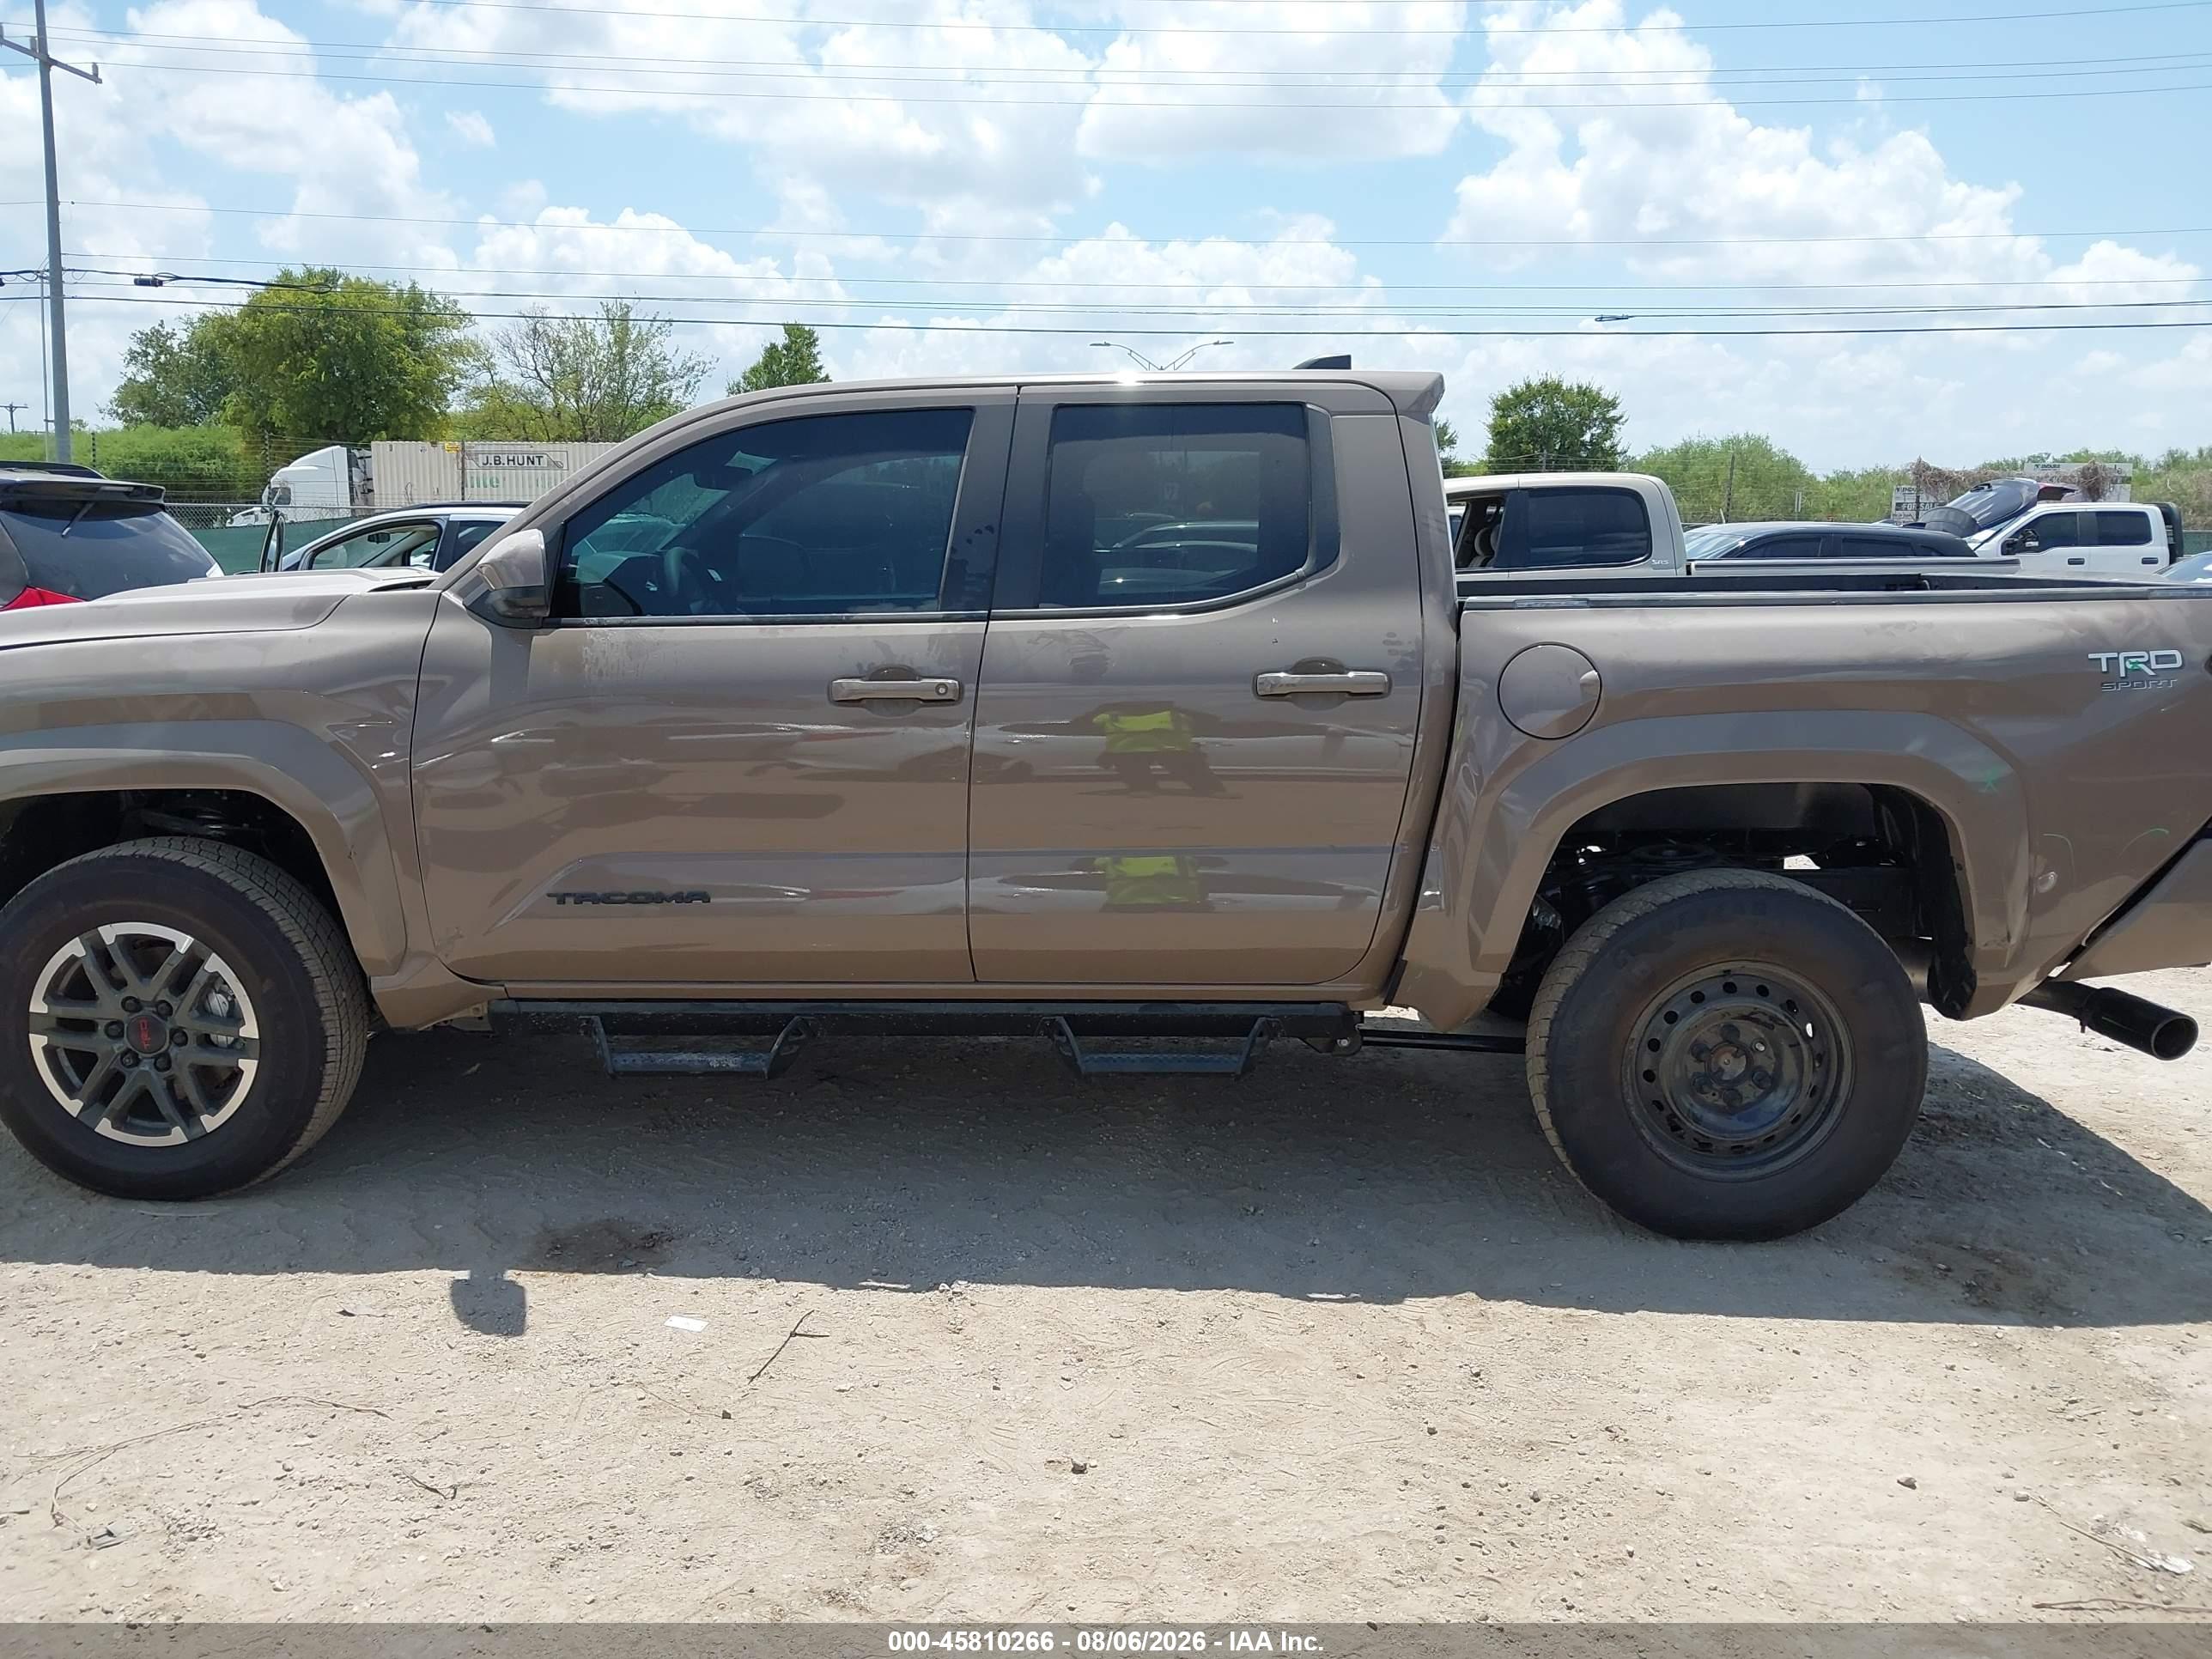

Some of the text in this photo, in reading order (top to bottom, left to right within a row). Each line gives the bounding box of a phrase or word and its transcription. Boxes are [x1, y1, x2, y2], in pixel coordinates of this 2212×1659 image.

[2087, 649, 2183, 677] TRD
[2101, 679, 2178, 692] SPORT
[546, 890, 711, 905] TACOMA
